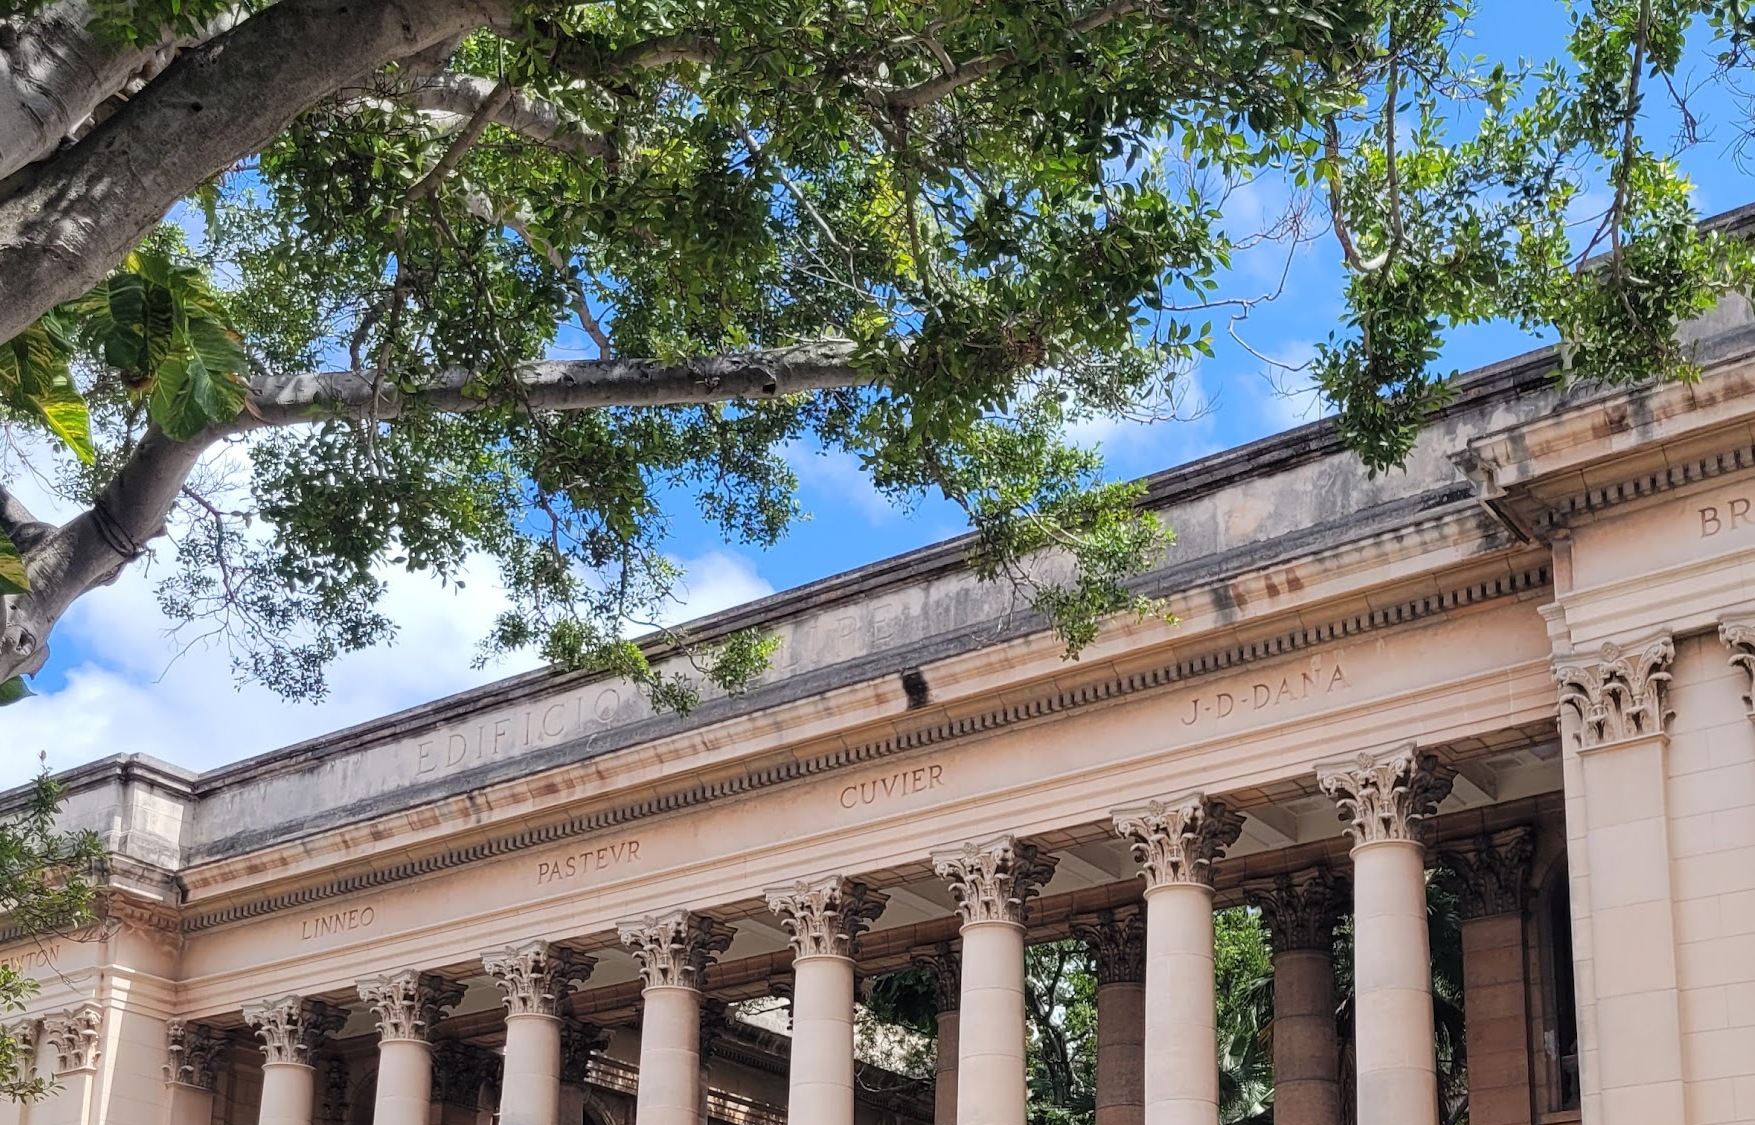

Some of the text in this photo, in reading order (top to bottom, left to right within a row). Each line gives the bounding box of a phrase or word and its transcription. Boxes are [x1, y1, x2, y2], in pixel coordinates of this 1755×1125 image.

[1697, 497, 1755, 538] BR
[416, 688, 621, 776] EDIFICIO
[840, 764, 945, 809] CUVIER
[302, 906, 375, 941] LINNEO
